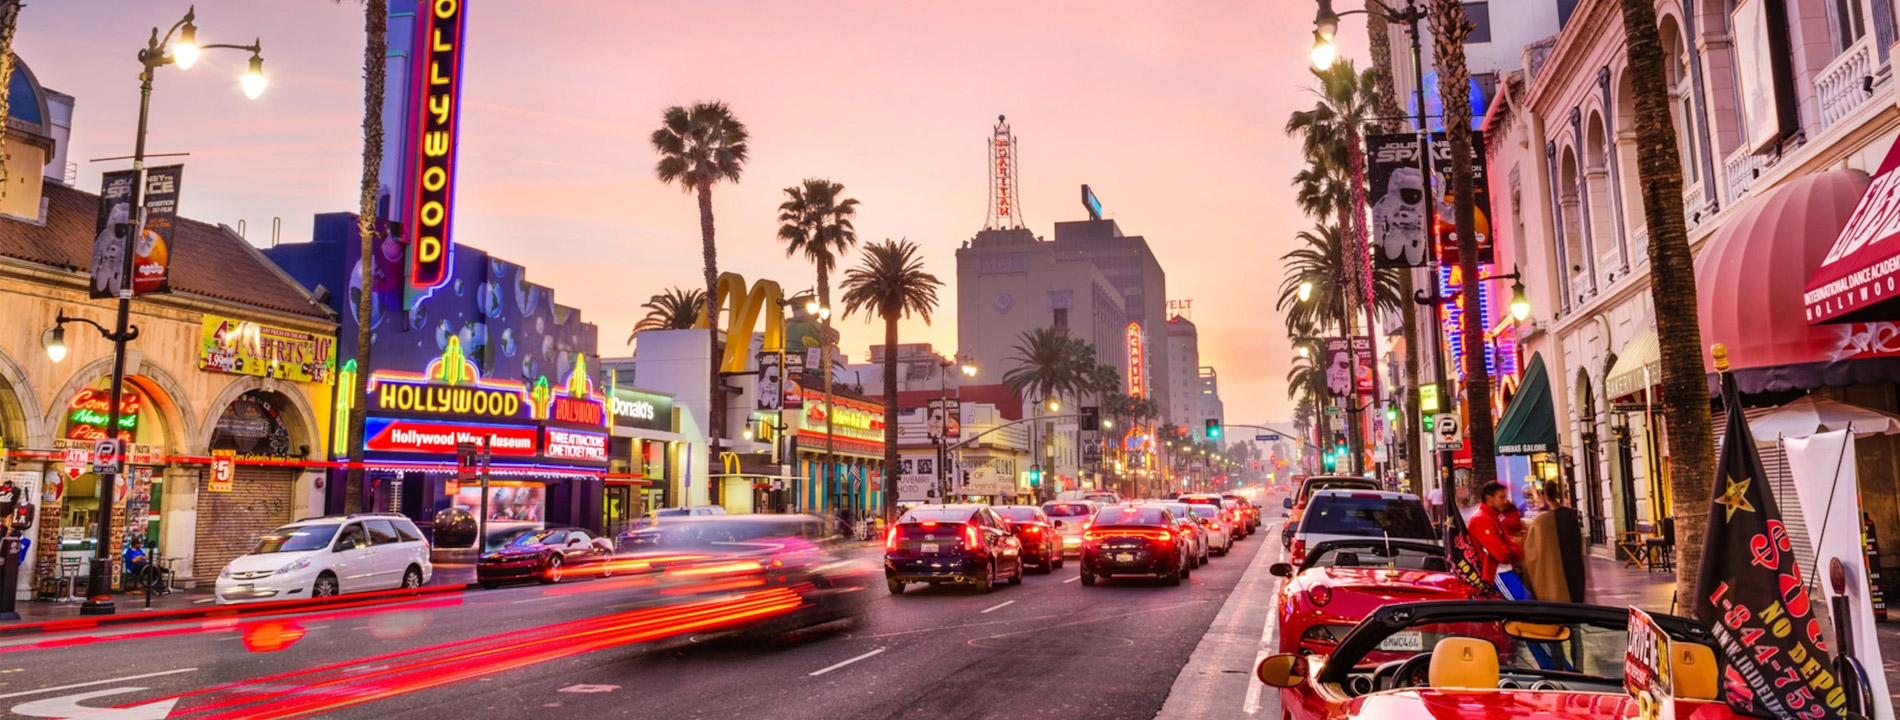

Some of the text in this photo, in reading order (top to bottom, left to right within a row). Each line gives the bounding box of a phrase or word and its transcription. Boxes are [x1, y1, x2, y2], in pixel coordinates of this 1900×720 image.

[1804, 277, 1849, 306] INTERNATIONAL
[1849, 267, 1870, 287] DANCE
[380, 384, 518, 416] HOLLYWOOD
[556, 399, 600, 425] HOLLYWOOD
[391, 429, 454, 447] Hollywood
[457, 432, 483, 446] Wax
[550, 431, 605, 447] THREE ATTRACTIONS
[68, 450, 86, 461] ATM
[134, 445, 150, 454] PASTA
[549, 444, 566, 456] ONE
[566, 445, 585, 458] TICKET
[1498, 443, 1547, 453] CAMERAS GALORE
[213, 461, 229, 481] $5
[974, 471, 984, 479] OF
[1758, 600, 1792, 638] NO
